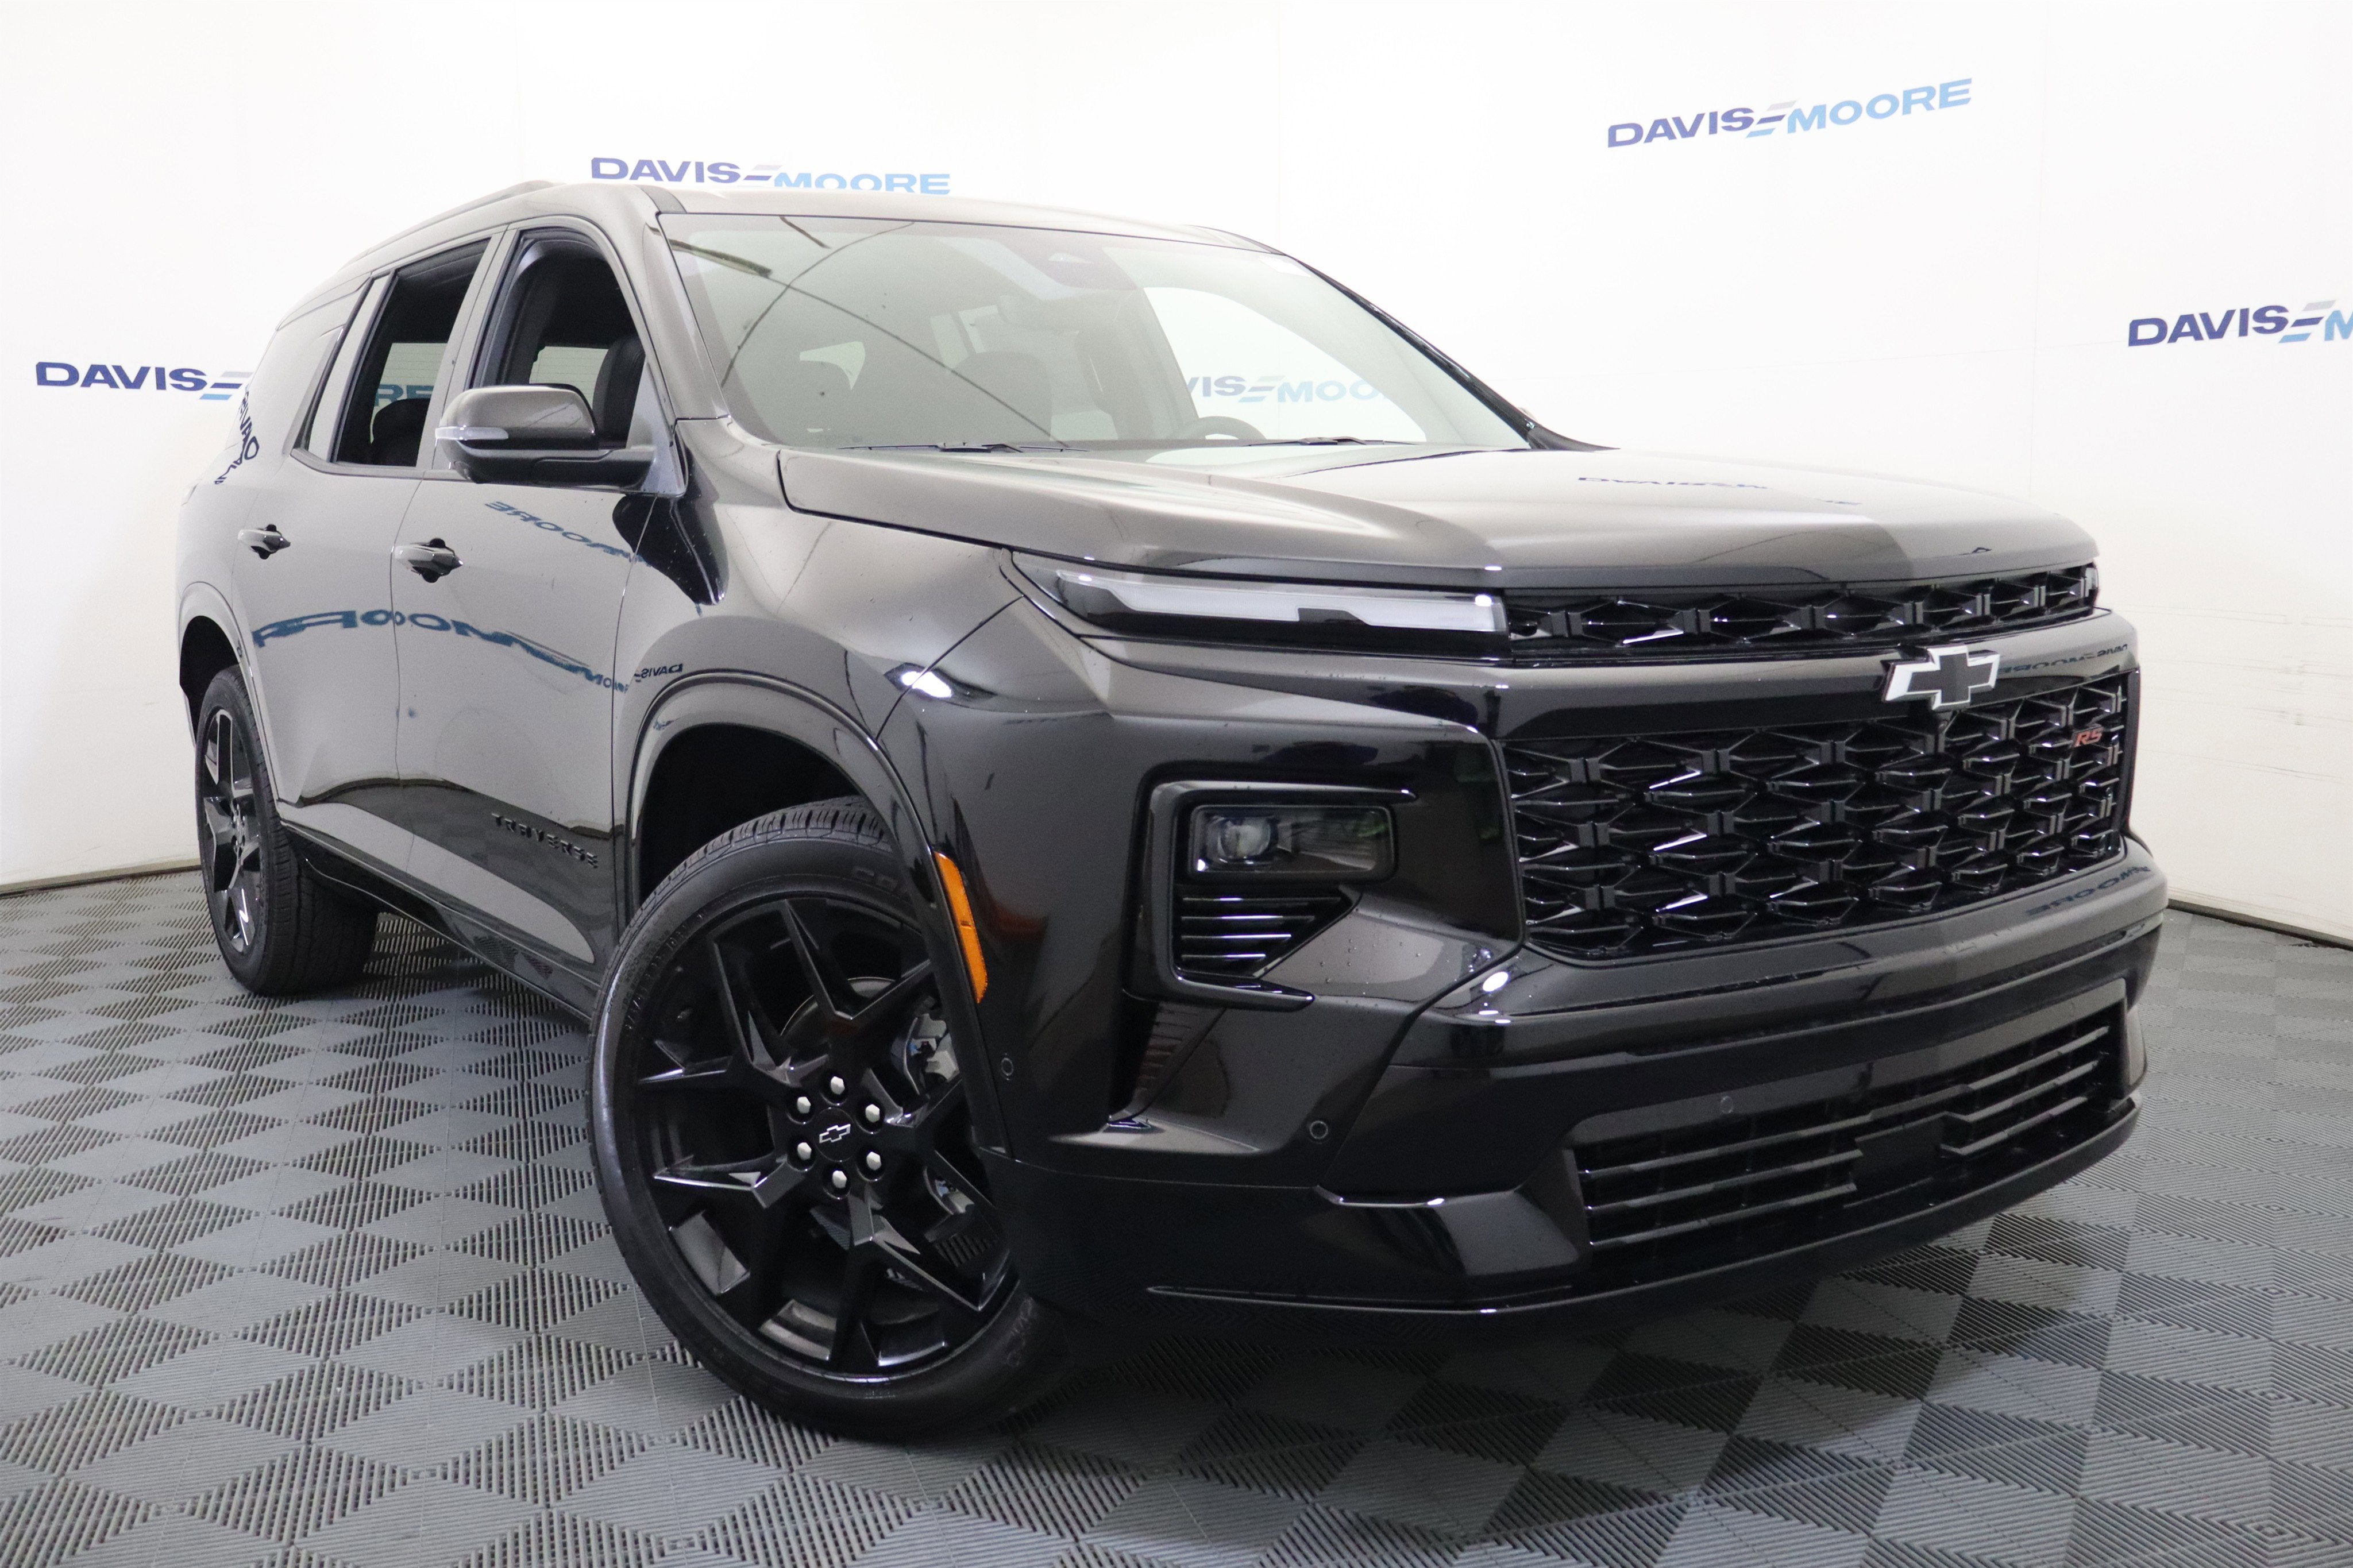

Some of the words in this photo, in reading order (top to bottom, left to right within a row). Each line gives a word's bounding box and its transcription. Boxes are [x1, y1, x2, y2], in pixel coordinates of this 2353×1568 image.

[1608, 107, 1754, 148] DAVIS
[1788, 78, 1972, 133] MOORE
[591, 157, 741, 183] DAVIS
[774, 172, 951, 195] MOORE
[2128, 305, 2289, 347] DAVIS
[36, 362, 208, 391] DAVIS
[1278, 380, 1386, 402] MOO
[2074, 726, 2104, 748] RS
[492, 813, 599, 869] TRAVERSE
